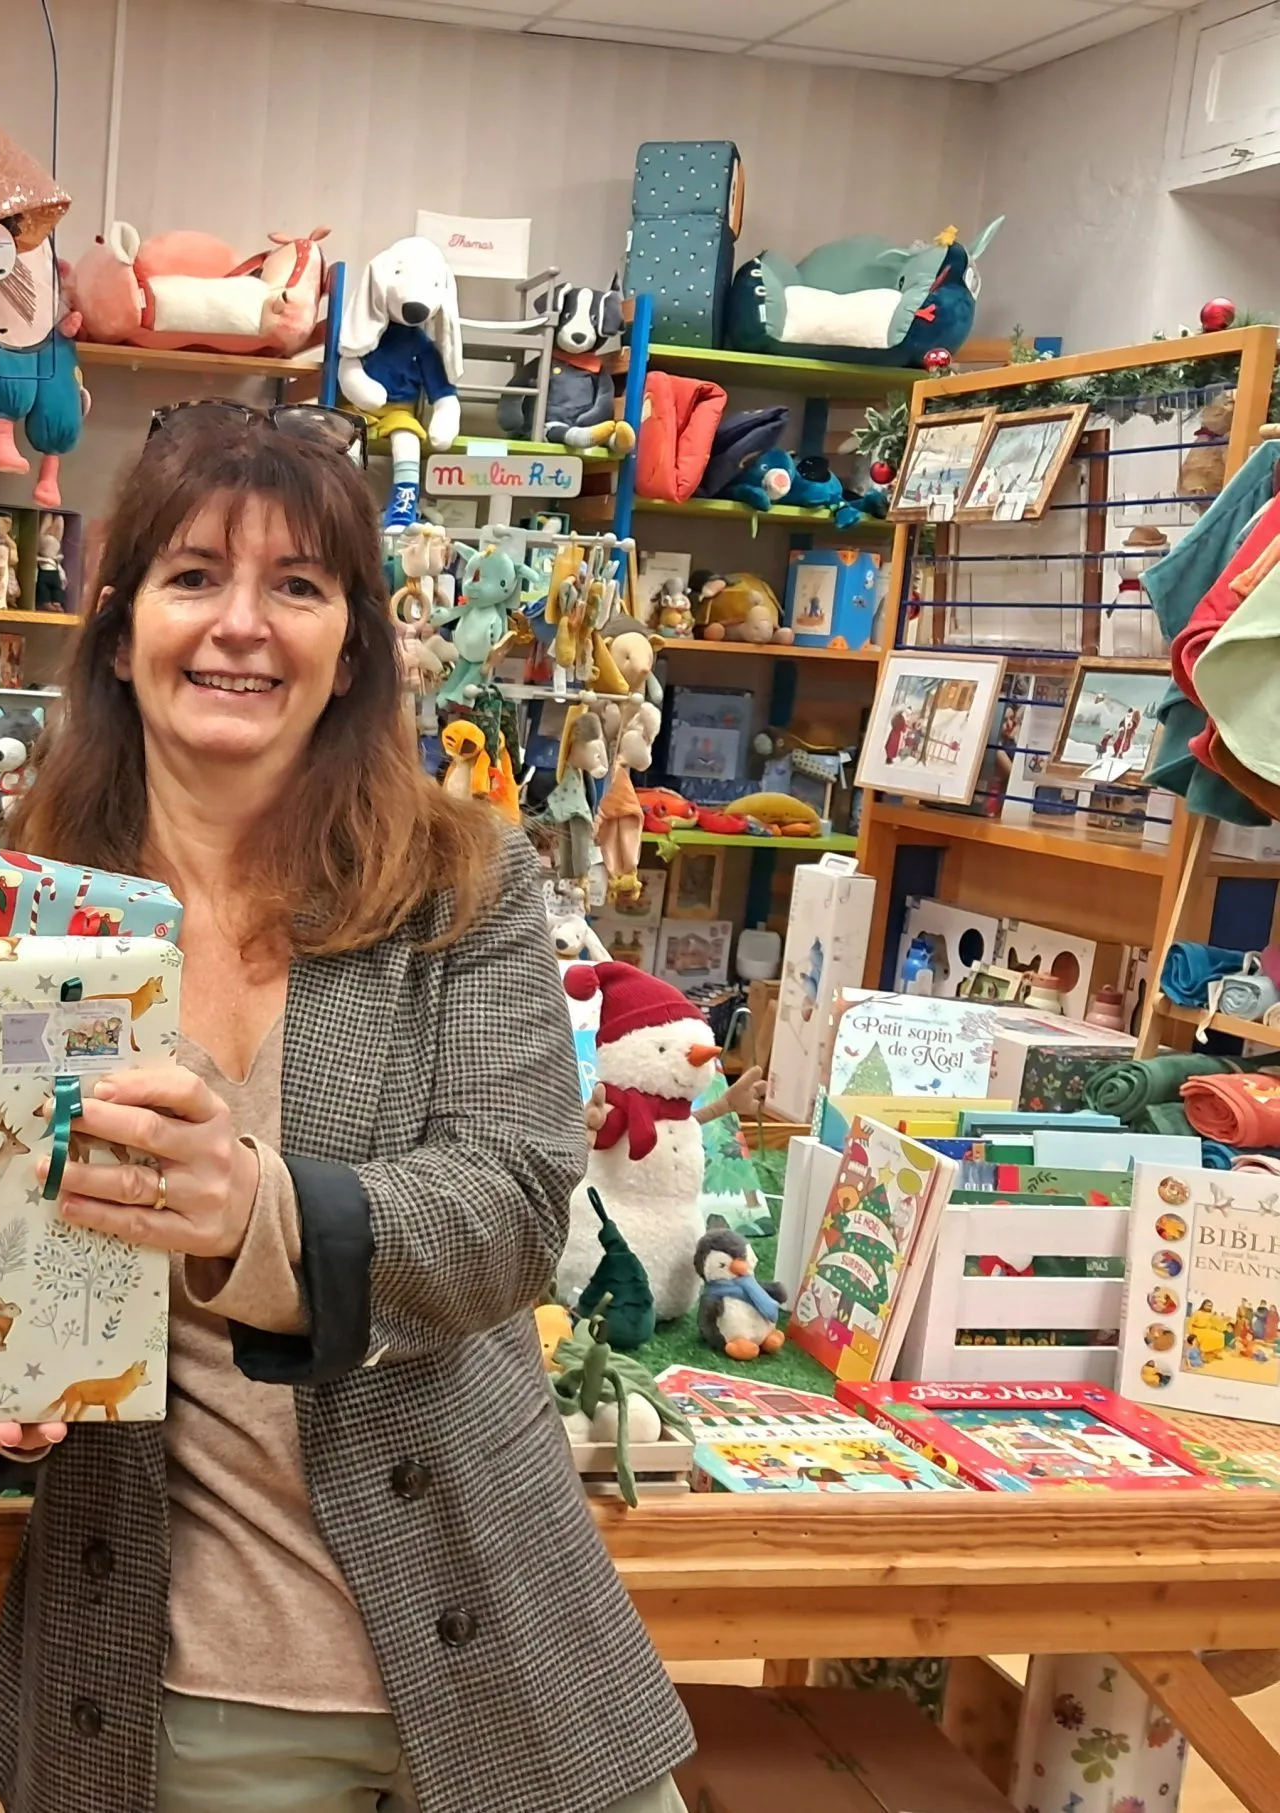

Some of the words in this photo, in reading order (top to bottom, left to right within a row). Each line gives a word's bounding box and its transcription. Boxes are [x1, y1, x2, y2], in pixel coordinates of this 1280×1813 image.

[448, 233, 494, 250] Thomas
[852, 1015, 902, 1037] Petit
[907, 1025, 953, 1046] sapin
[888, 1040, 907, 1057] de
[911, 1045, 964, 1073] Noël
[853, 1212, 863, 1225] LE
[1199, 1225, 1280, 1254] BIBLE
[841, 1254, 872, 1285] SURPRISE
[909, 1385, 990, 1400] Père
[994, 1384, 1073, 1400] Noël
